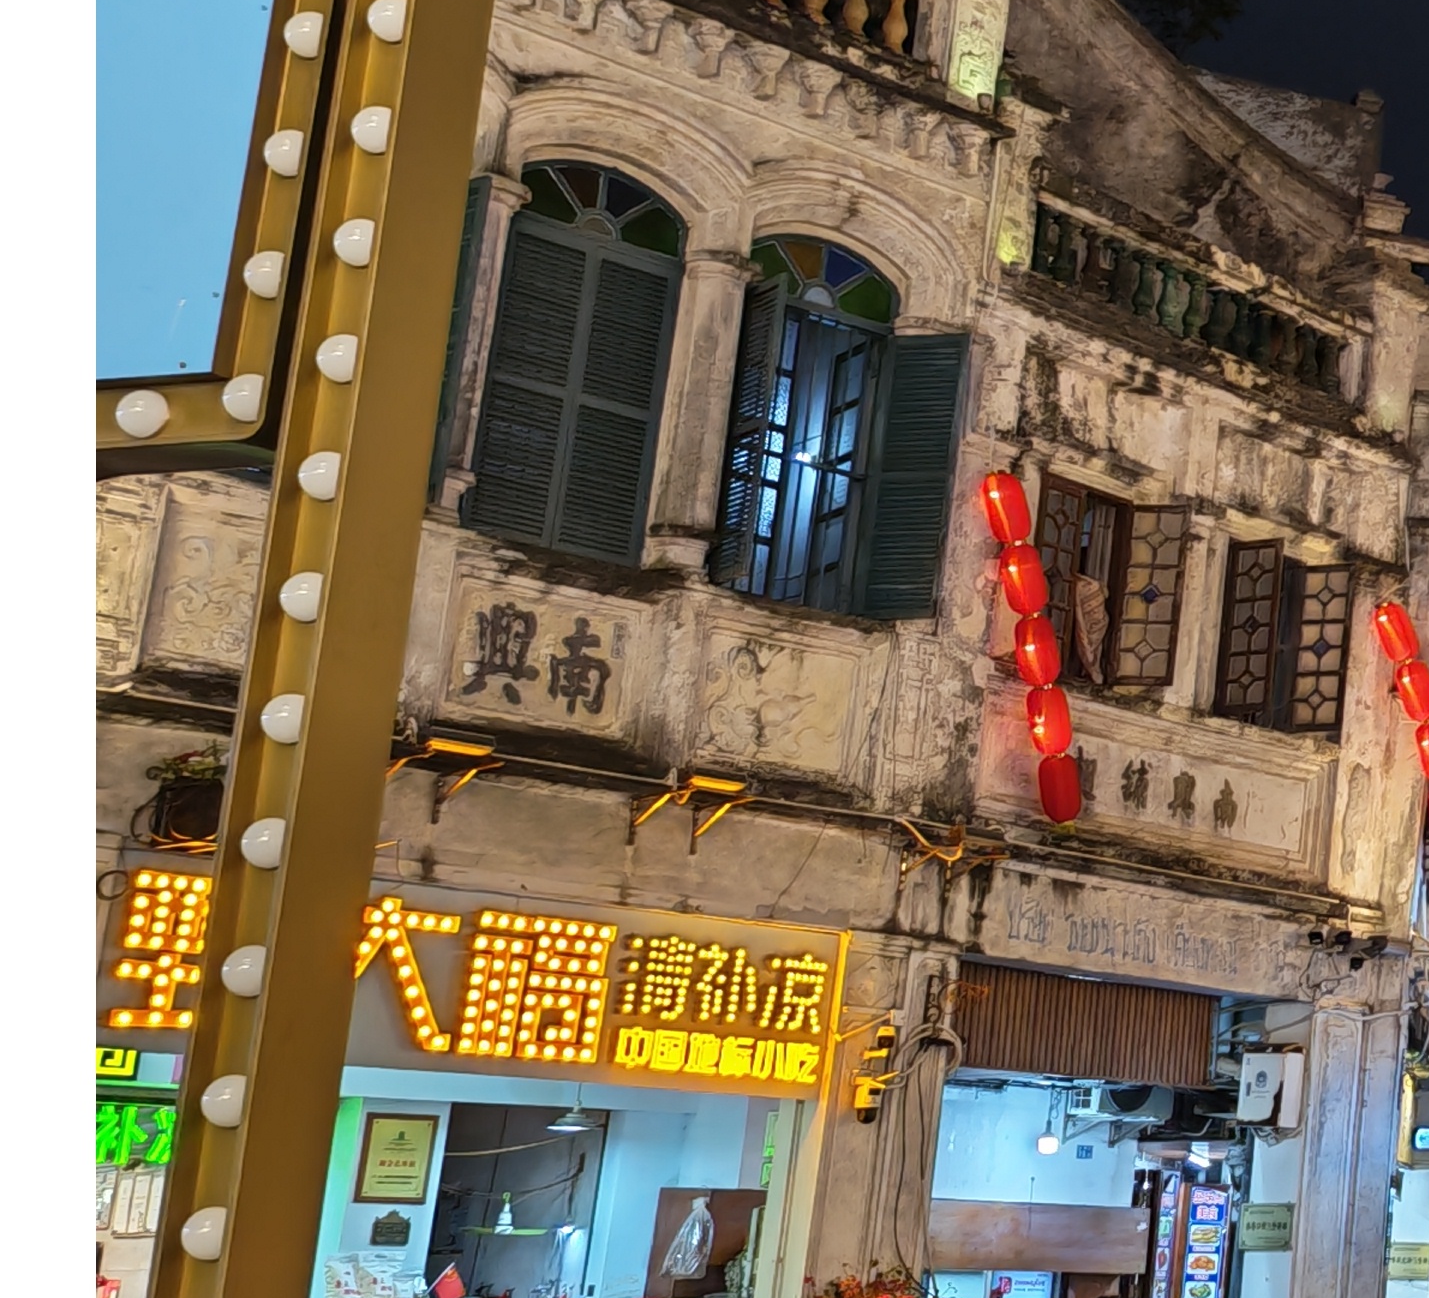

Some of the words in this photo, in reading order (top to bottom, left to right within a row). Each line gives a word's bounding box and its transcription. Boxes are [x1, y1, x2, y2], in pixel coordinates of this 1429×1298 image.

[615, 1026, 820, 1083] 中国地标小吃
